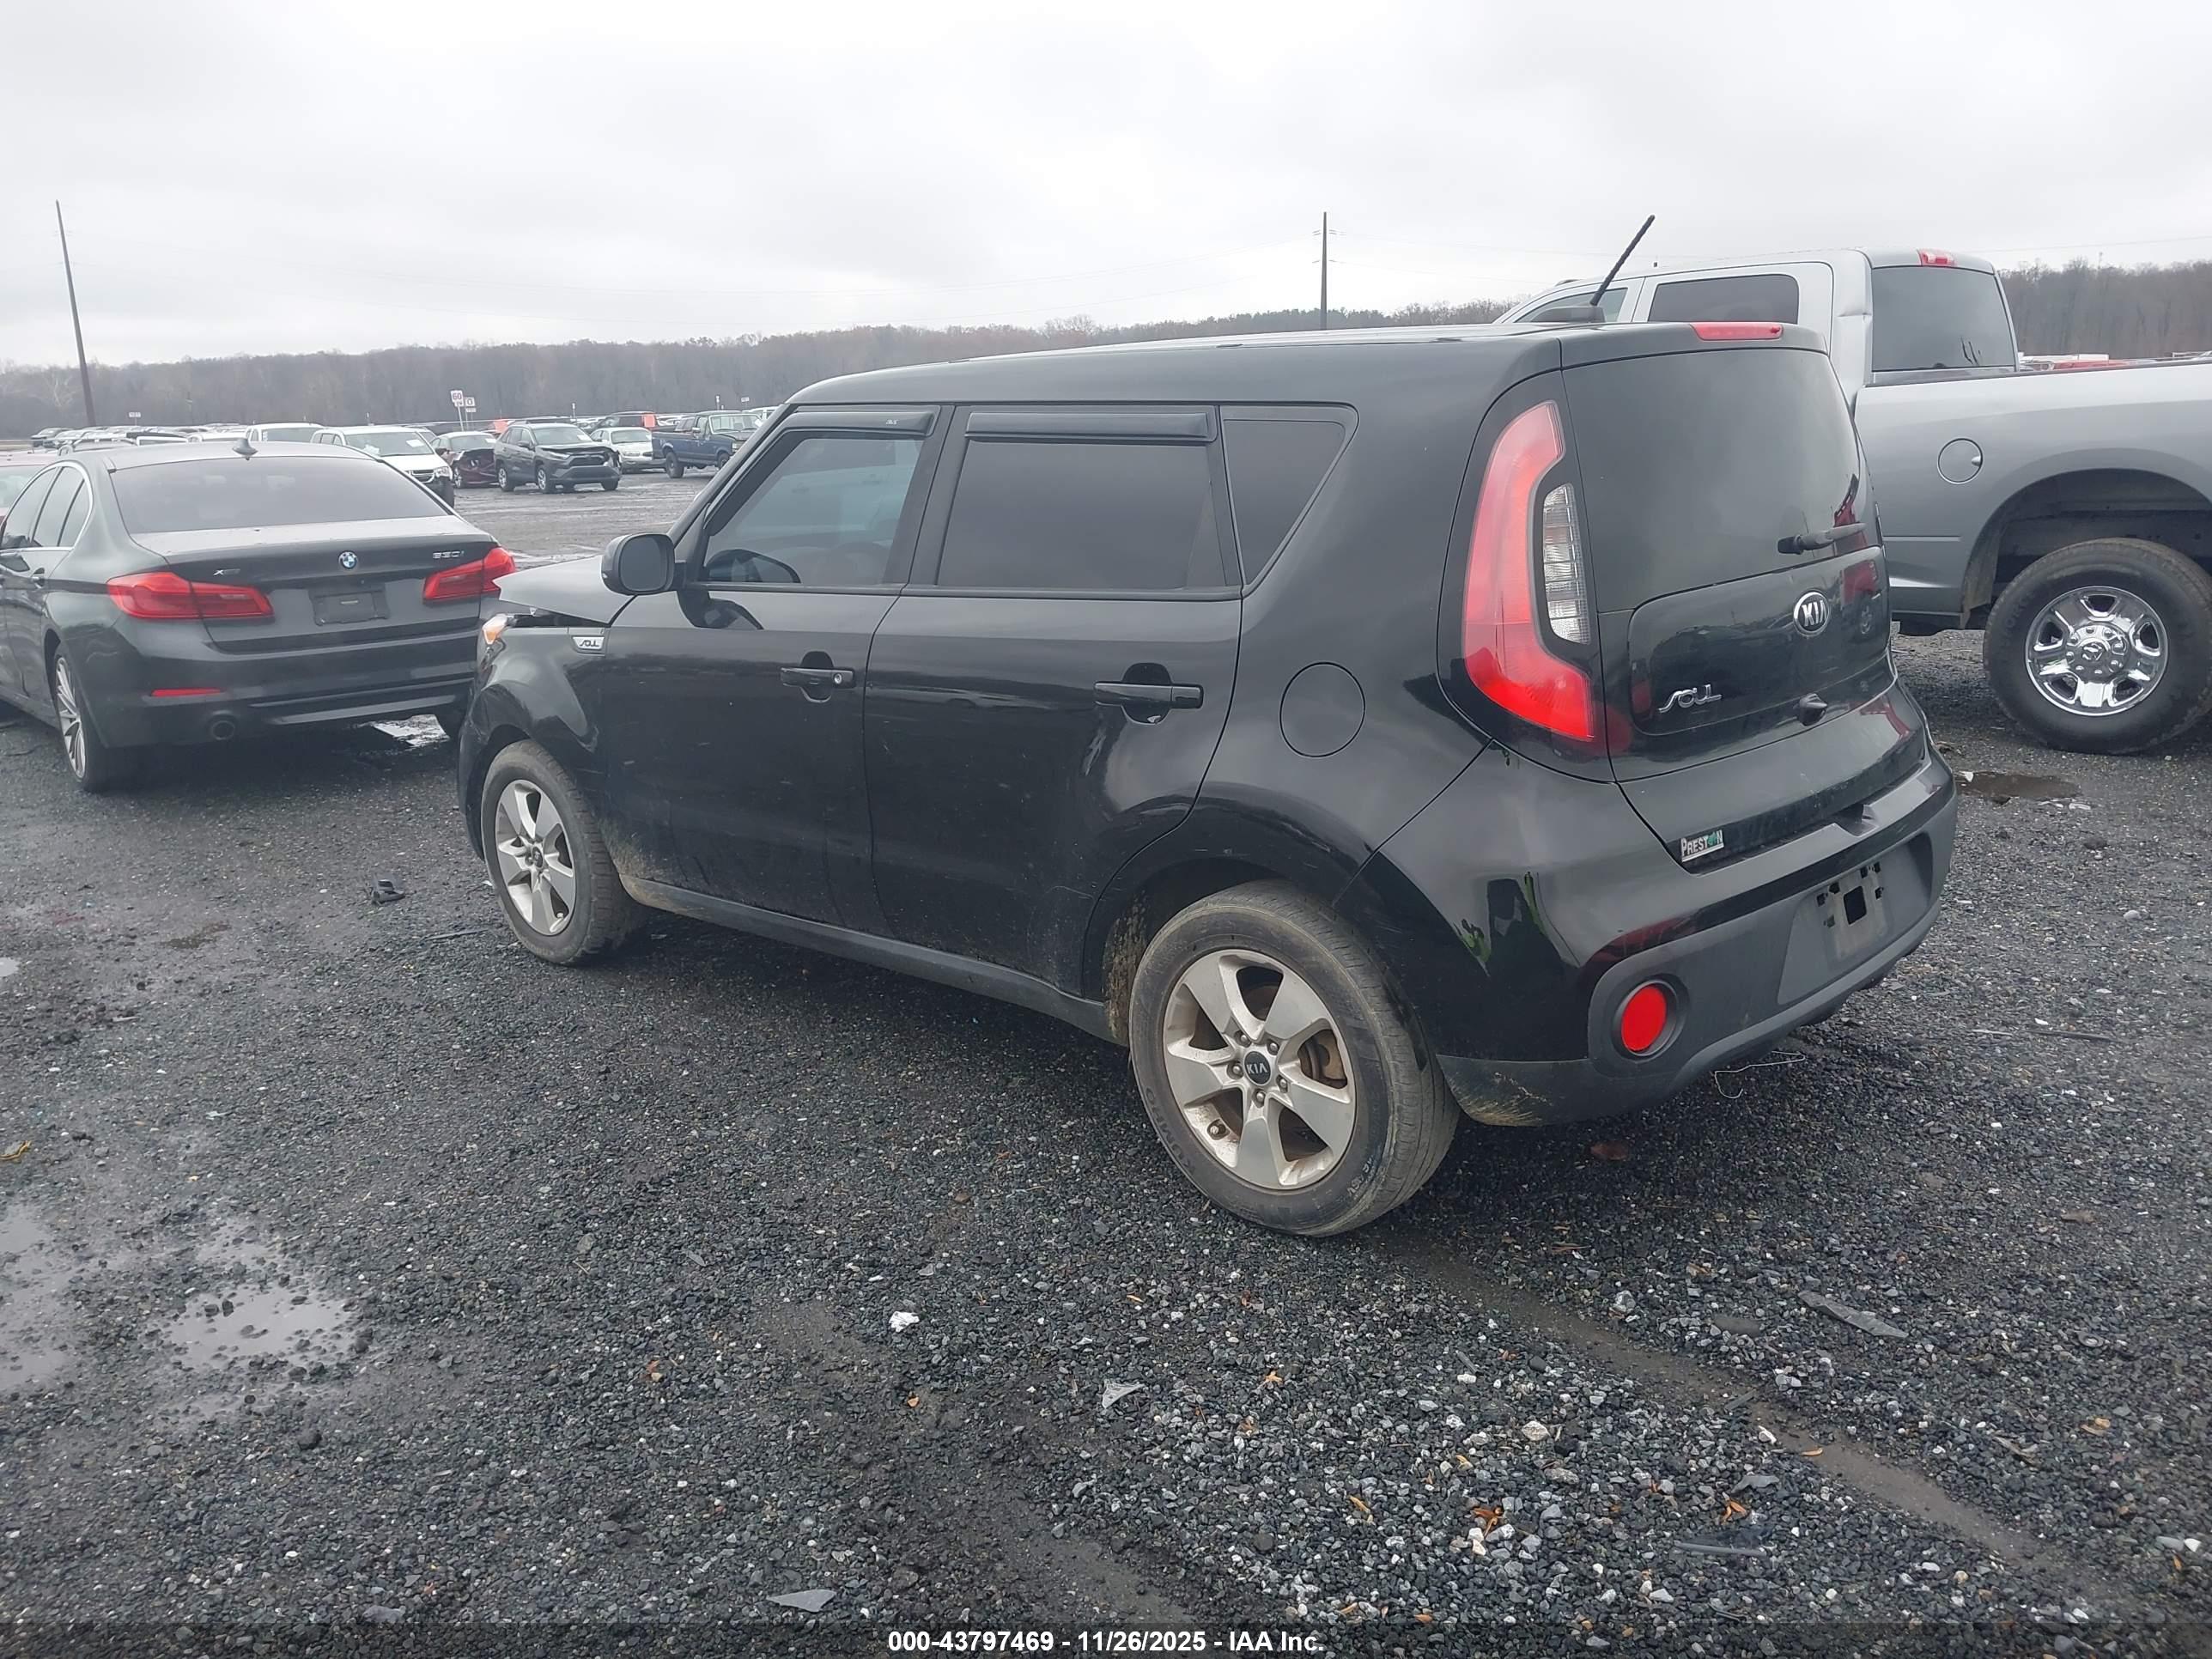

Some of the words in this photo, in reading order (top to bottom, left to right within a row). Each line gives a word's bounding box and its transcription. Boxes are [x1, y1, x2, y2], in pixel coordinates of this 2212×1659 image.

[1802, 600, 1827, 627] KIA
[1680, 829, 1723, 857] PRESTN
[1246, 1062, 1268, 1074] KIA
